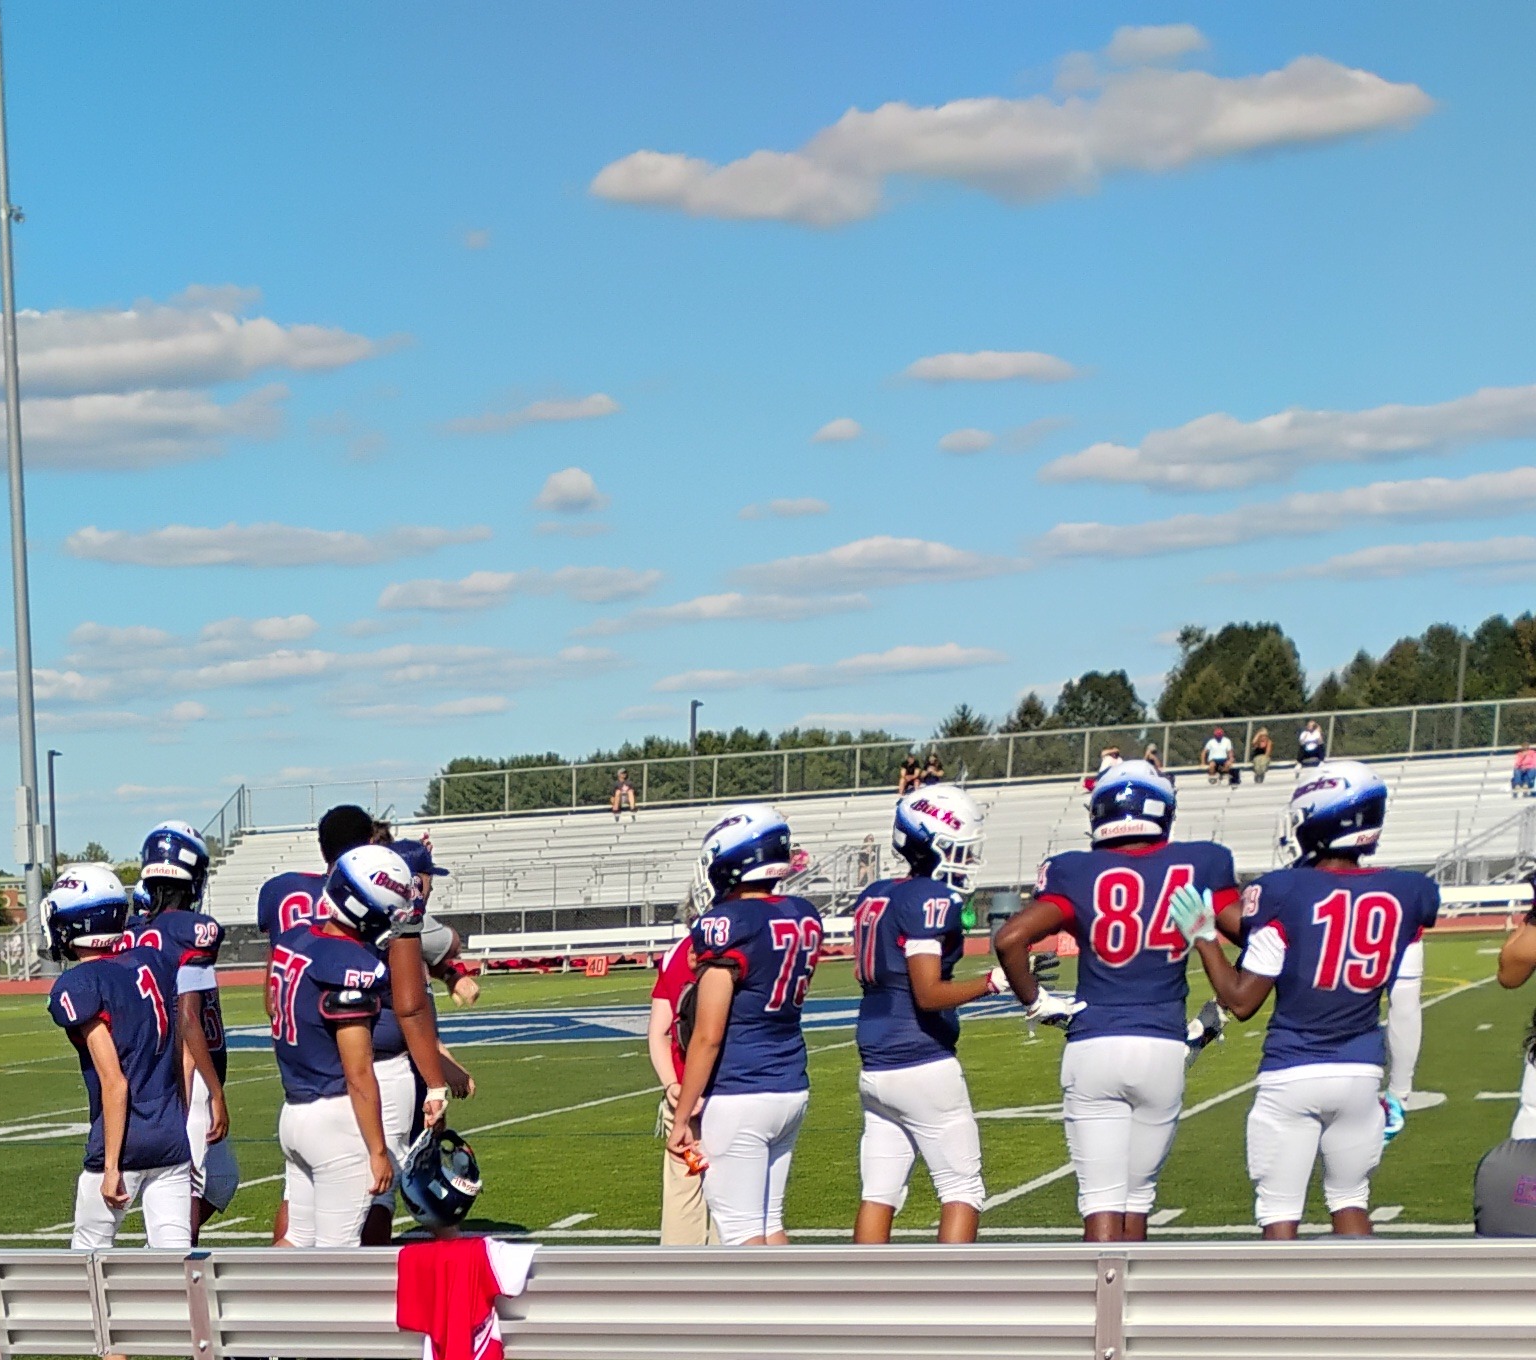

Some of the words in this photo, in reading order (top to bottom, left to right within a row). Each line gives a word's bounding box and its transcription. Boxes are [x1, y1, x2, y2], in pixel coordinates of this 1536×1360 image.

[194, 922, 219, 947] 29
[701, 916, 731, 946] 73
[923, 898, 951, 928] 17
[1090, 864, 1195, 968] 84
[1313, 889, 1403, 993] 19
[345, 969, 376, 989] 57
[764, 917, 823, 1011] 73
[60, 991, 77, 1022] 1
[136, 965, 169, 1056] 1
[270, 944, 313, 1046] 57
